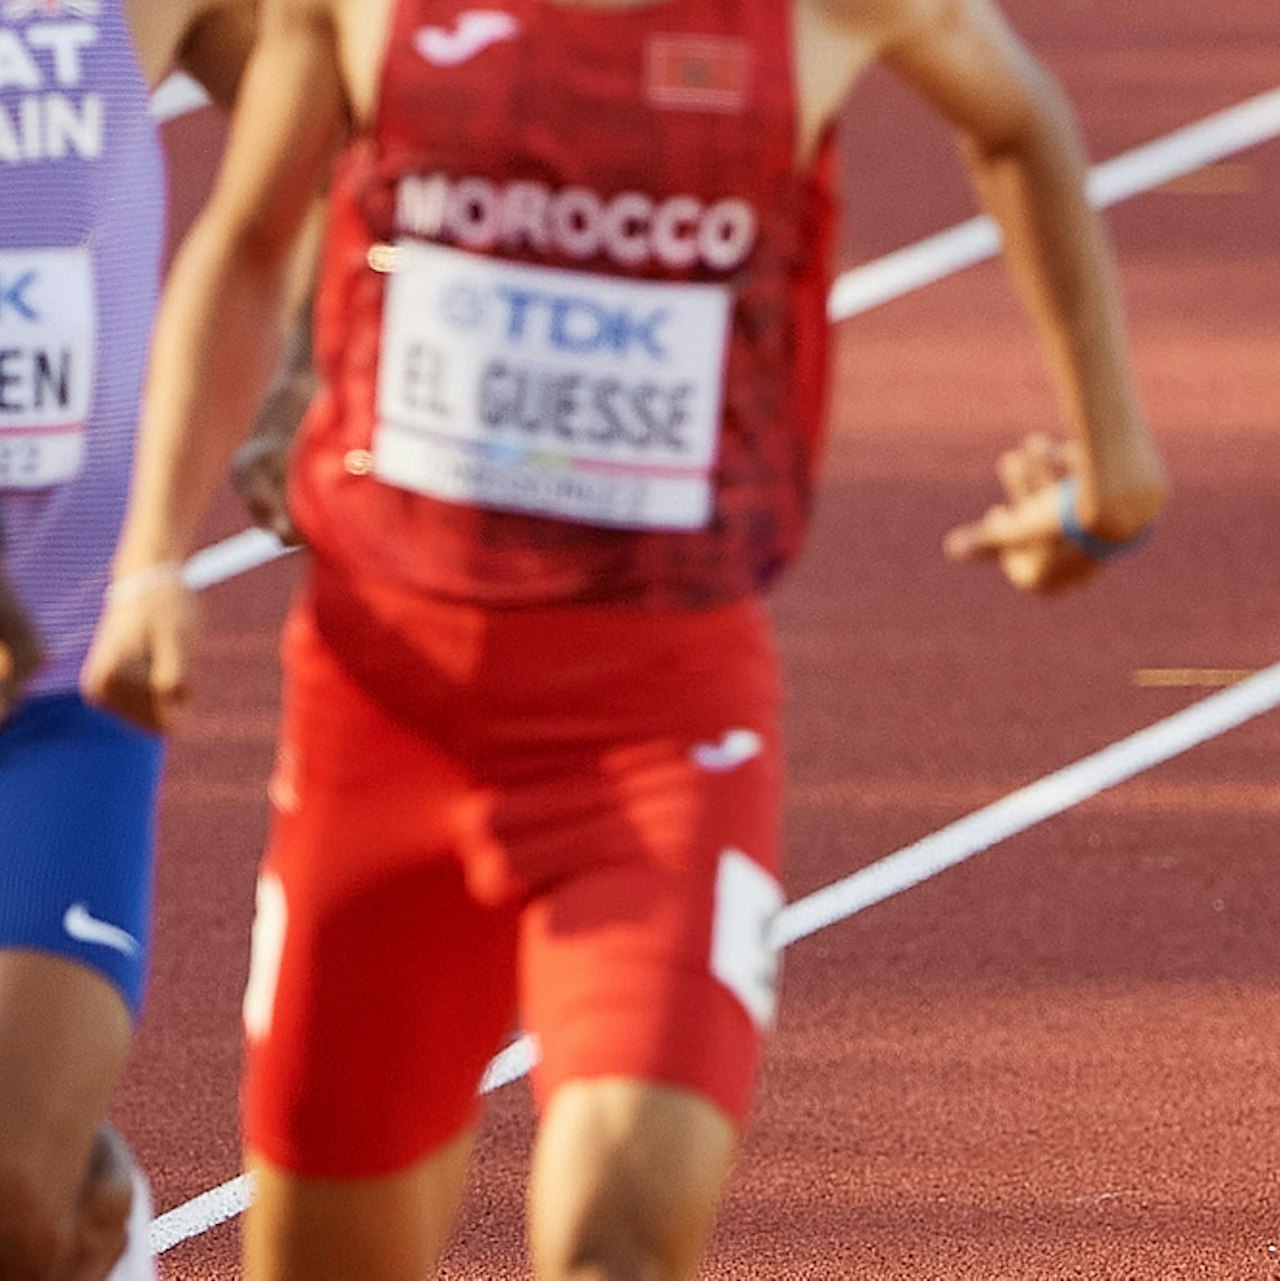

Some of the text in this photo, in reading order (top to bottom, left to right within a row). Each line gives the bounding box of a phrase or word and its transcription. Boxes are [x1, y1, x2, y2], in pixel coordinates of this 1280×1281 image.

[396, 172, 757, 270] MOROCCO
[497, 284, 669, 361] TDK
[477, 359, 692, 453] GUESSE
